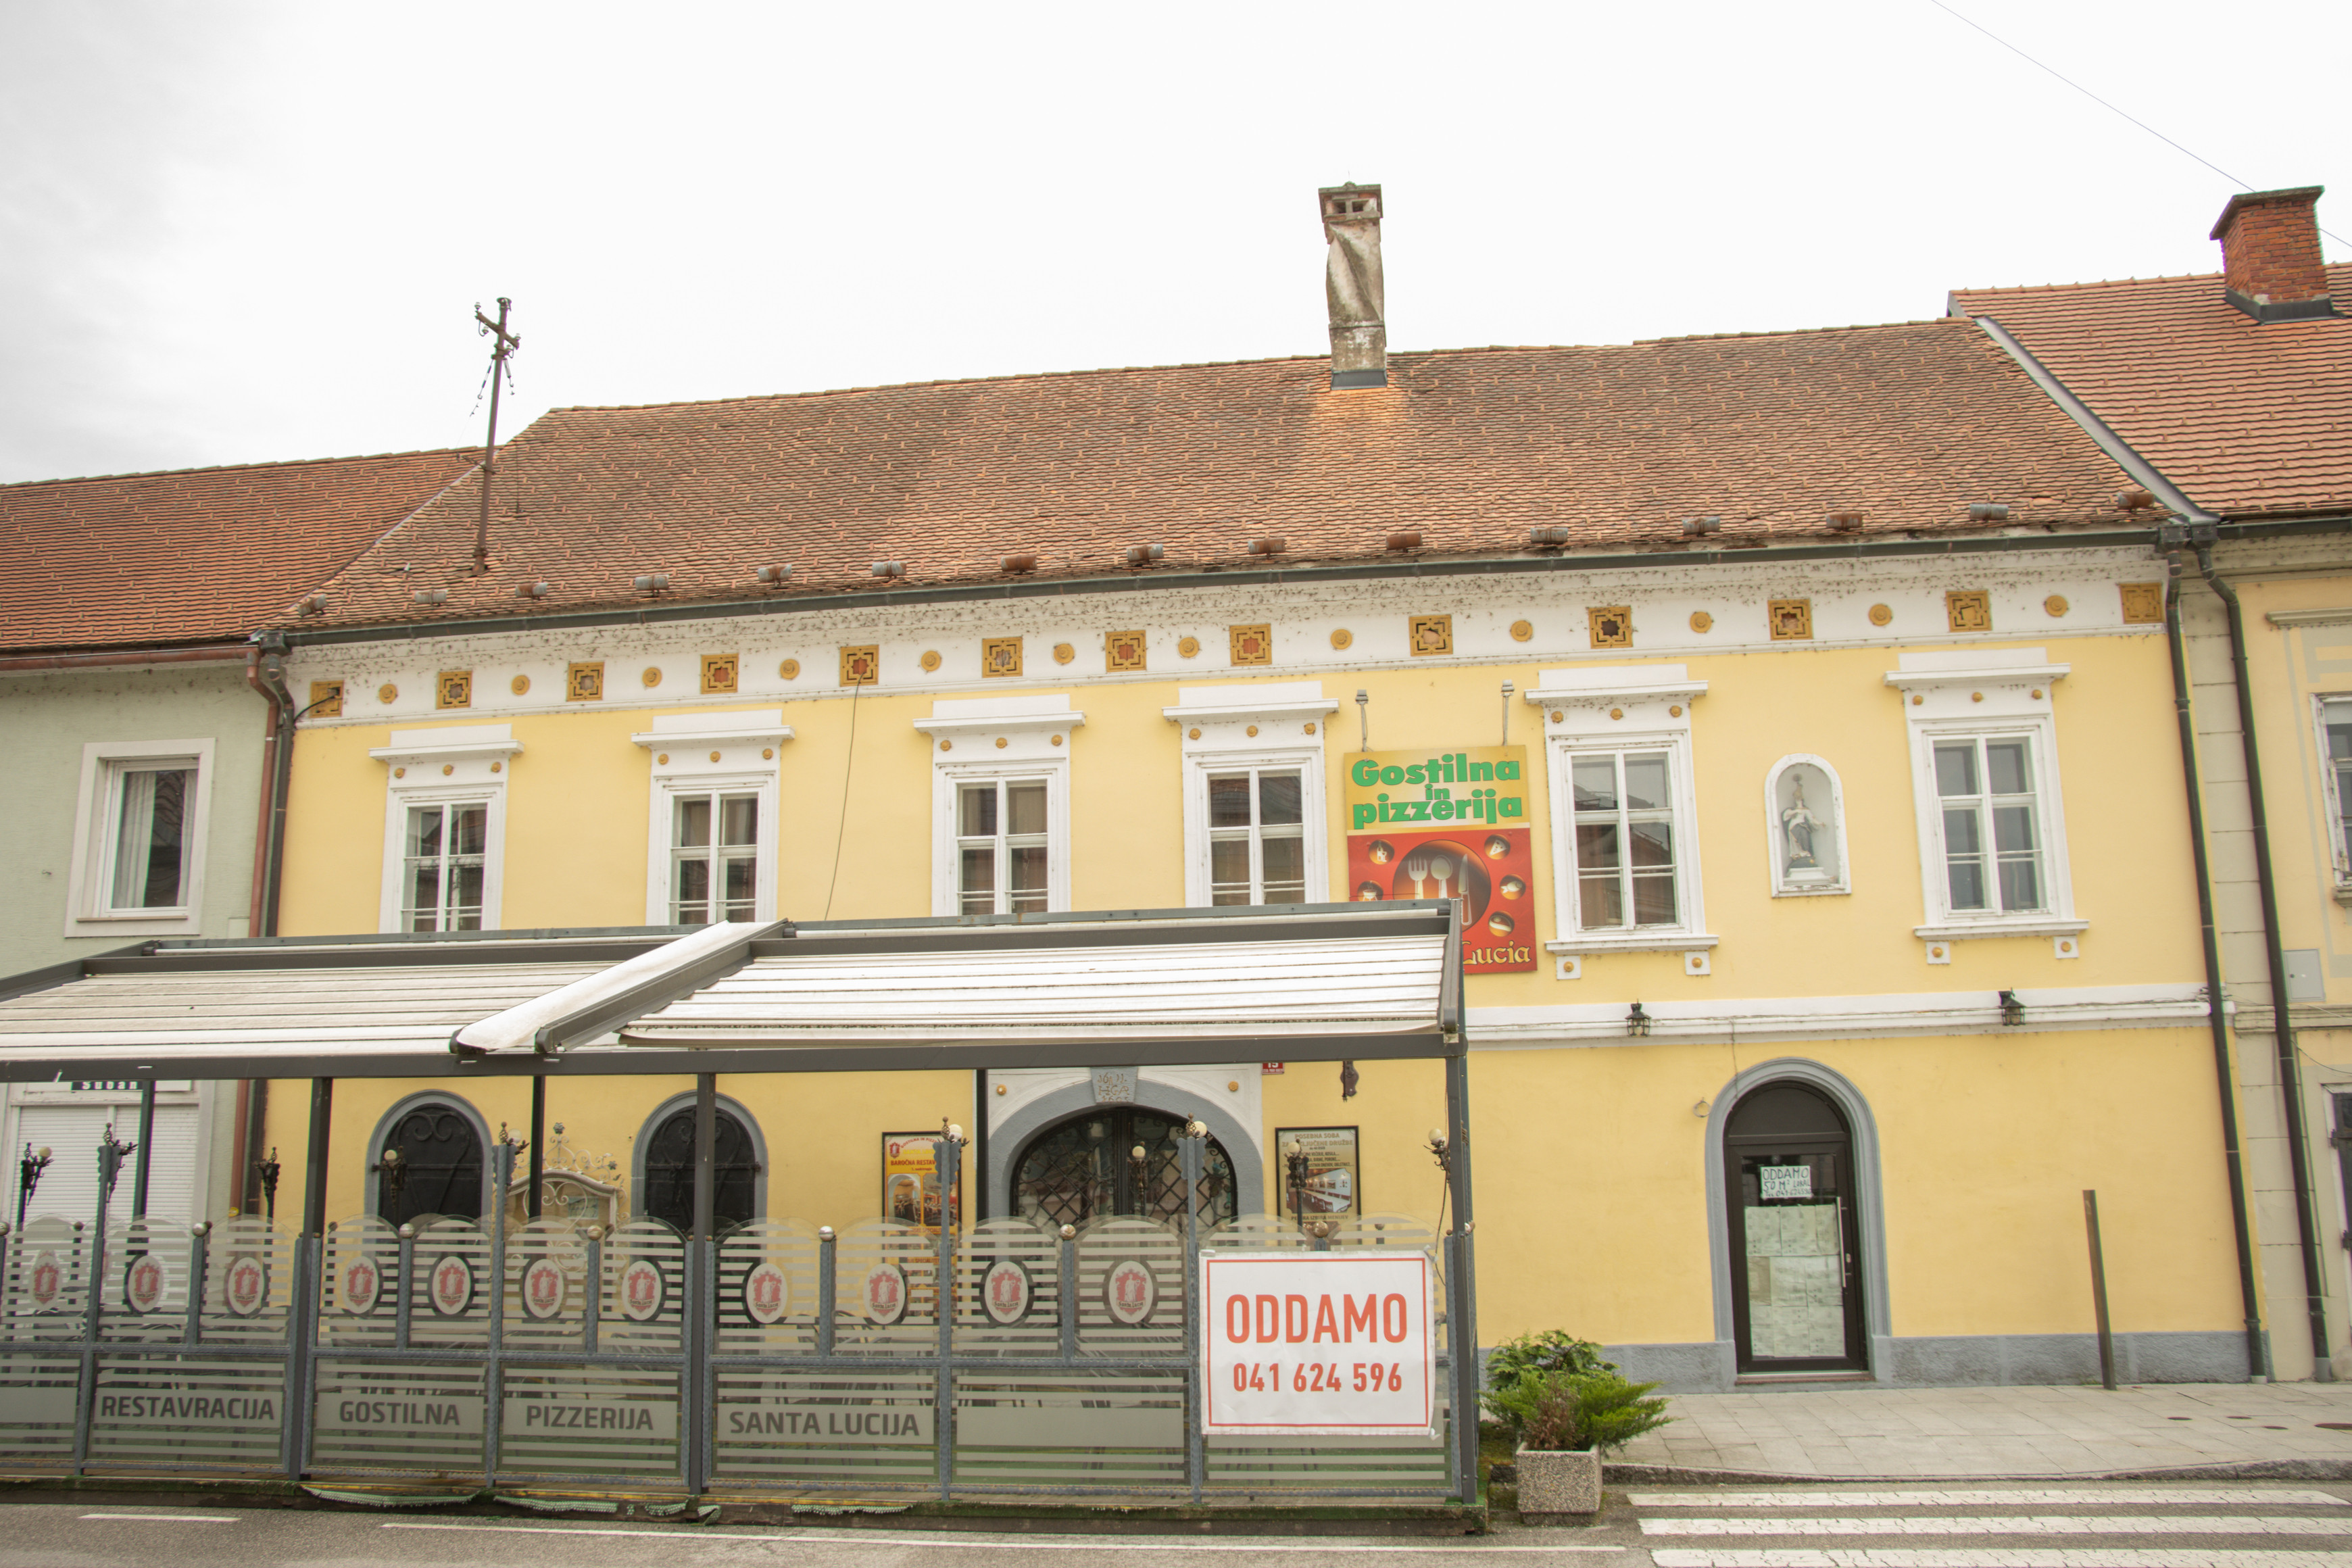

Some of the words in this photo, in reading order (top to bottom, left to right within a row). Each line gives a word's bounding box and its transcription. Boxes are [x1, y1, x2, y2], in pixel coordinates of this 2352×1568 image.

[1352, 754, 1520, 786] Gostilna
[1425, 783, 1450, 800] in
[1353, 789, 1522, 829] pizzerija
[1763, 1168, 1809, 1180] ODDAMO
[1765, 1181, 1775, 1190] 50
[1227, 1294, 1407, 1343] ODDAMO
[1233, 1363, 1279, 1392] 041
[1294, 1363, 1342, 1392] 624
[1353, 1363, 1402, 1392] 596
[101, 1396, 274, 1419] RESTAVRACIJA
[340, 1400, 460, 1425] GOSTILNA
[526, 1405, 654, 1430] PIZZERIJA
[730, 1411, 820, 1434] SANTA
[829, 1413, 919, 1436] LUCIJA
